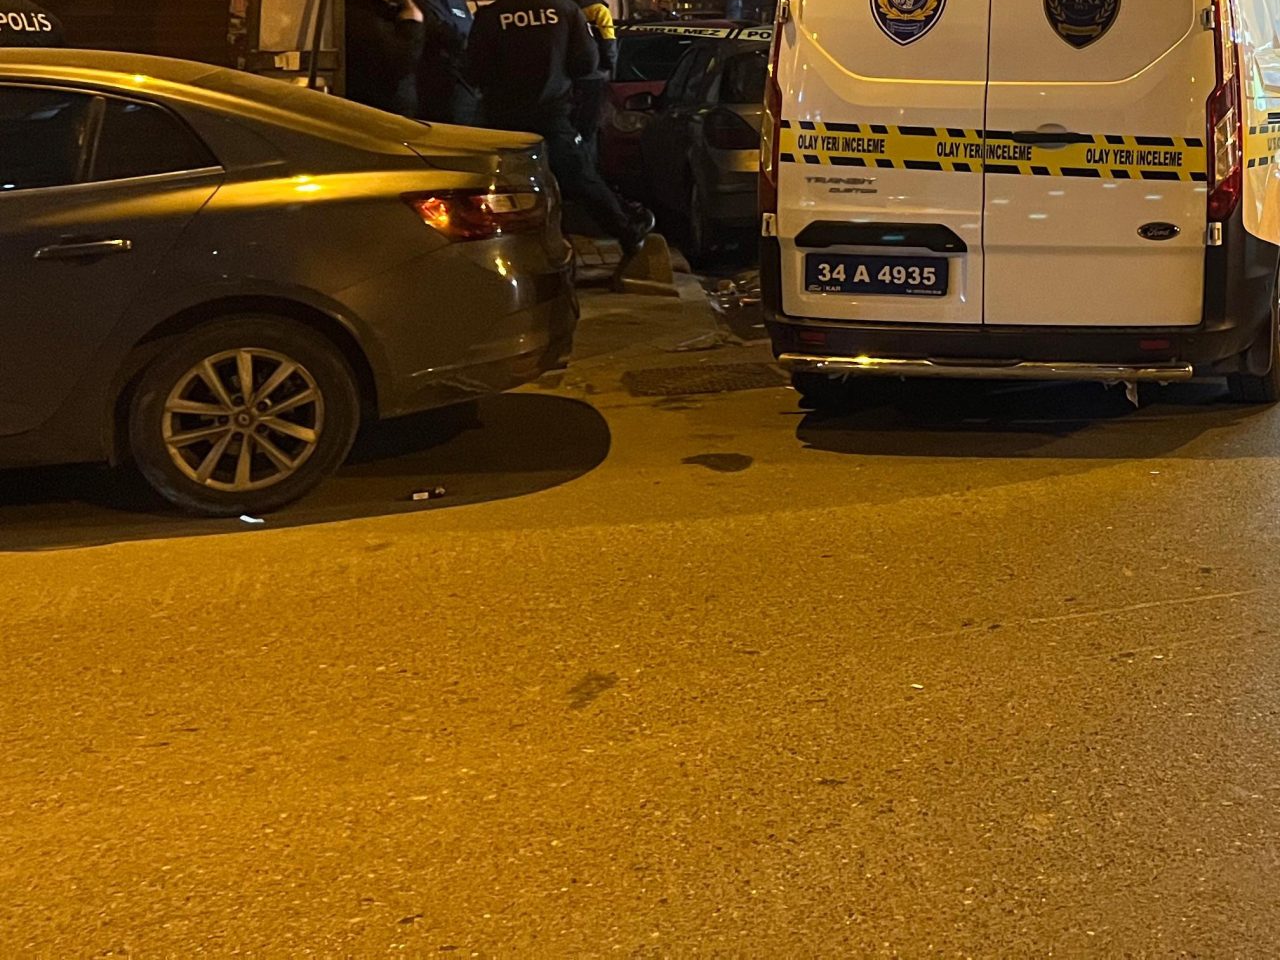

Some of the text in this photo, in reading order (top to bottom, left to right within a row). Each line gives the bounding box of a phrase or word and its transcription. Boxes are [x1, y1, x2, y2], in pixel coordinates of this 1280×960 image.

[798, 134, 818, 150] OLAY
[937, 141, 961, 158] OLAY
[1086, 148, 1110, 164] OLAY
[818, 263, 936, 286] 34 A 4935
